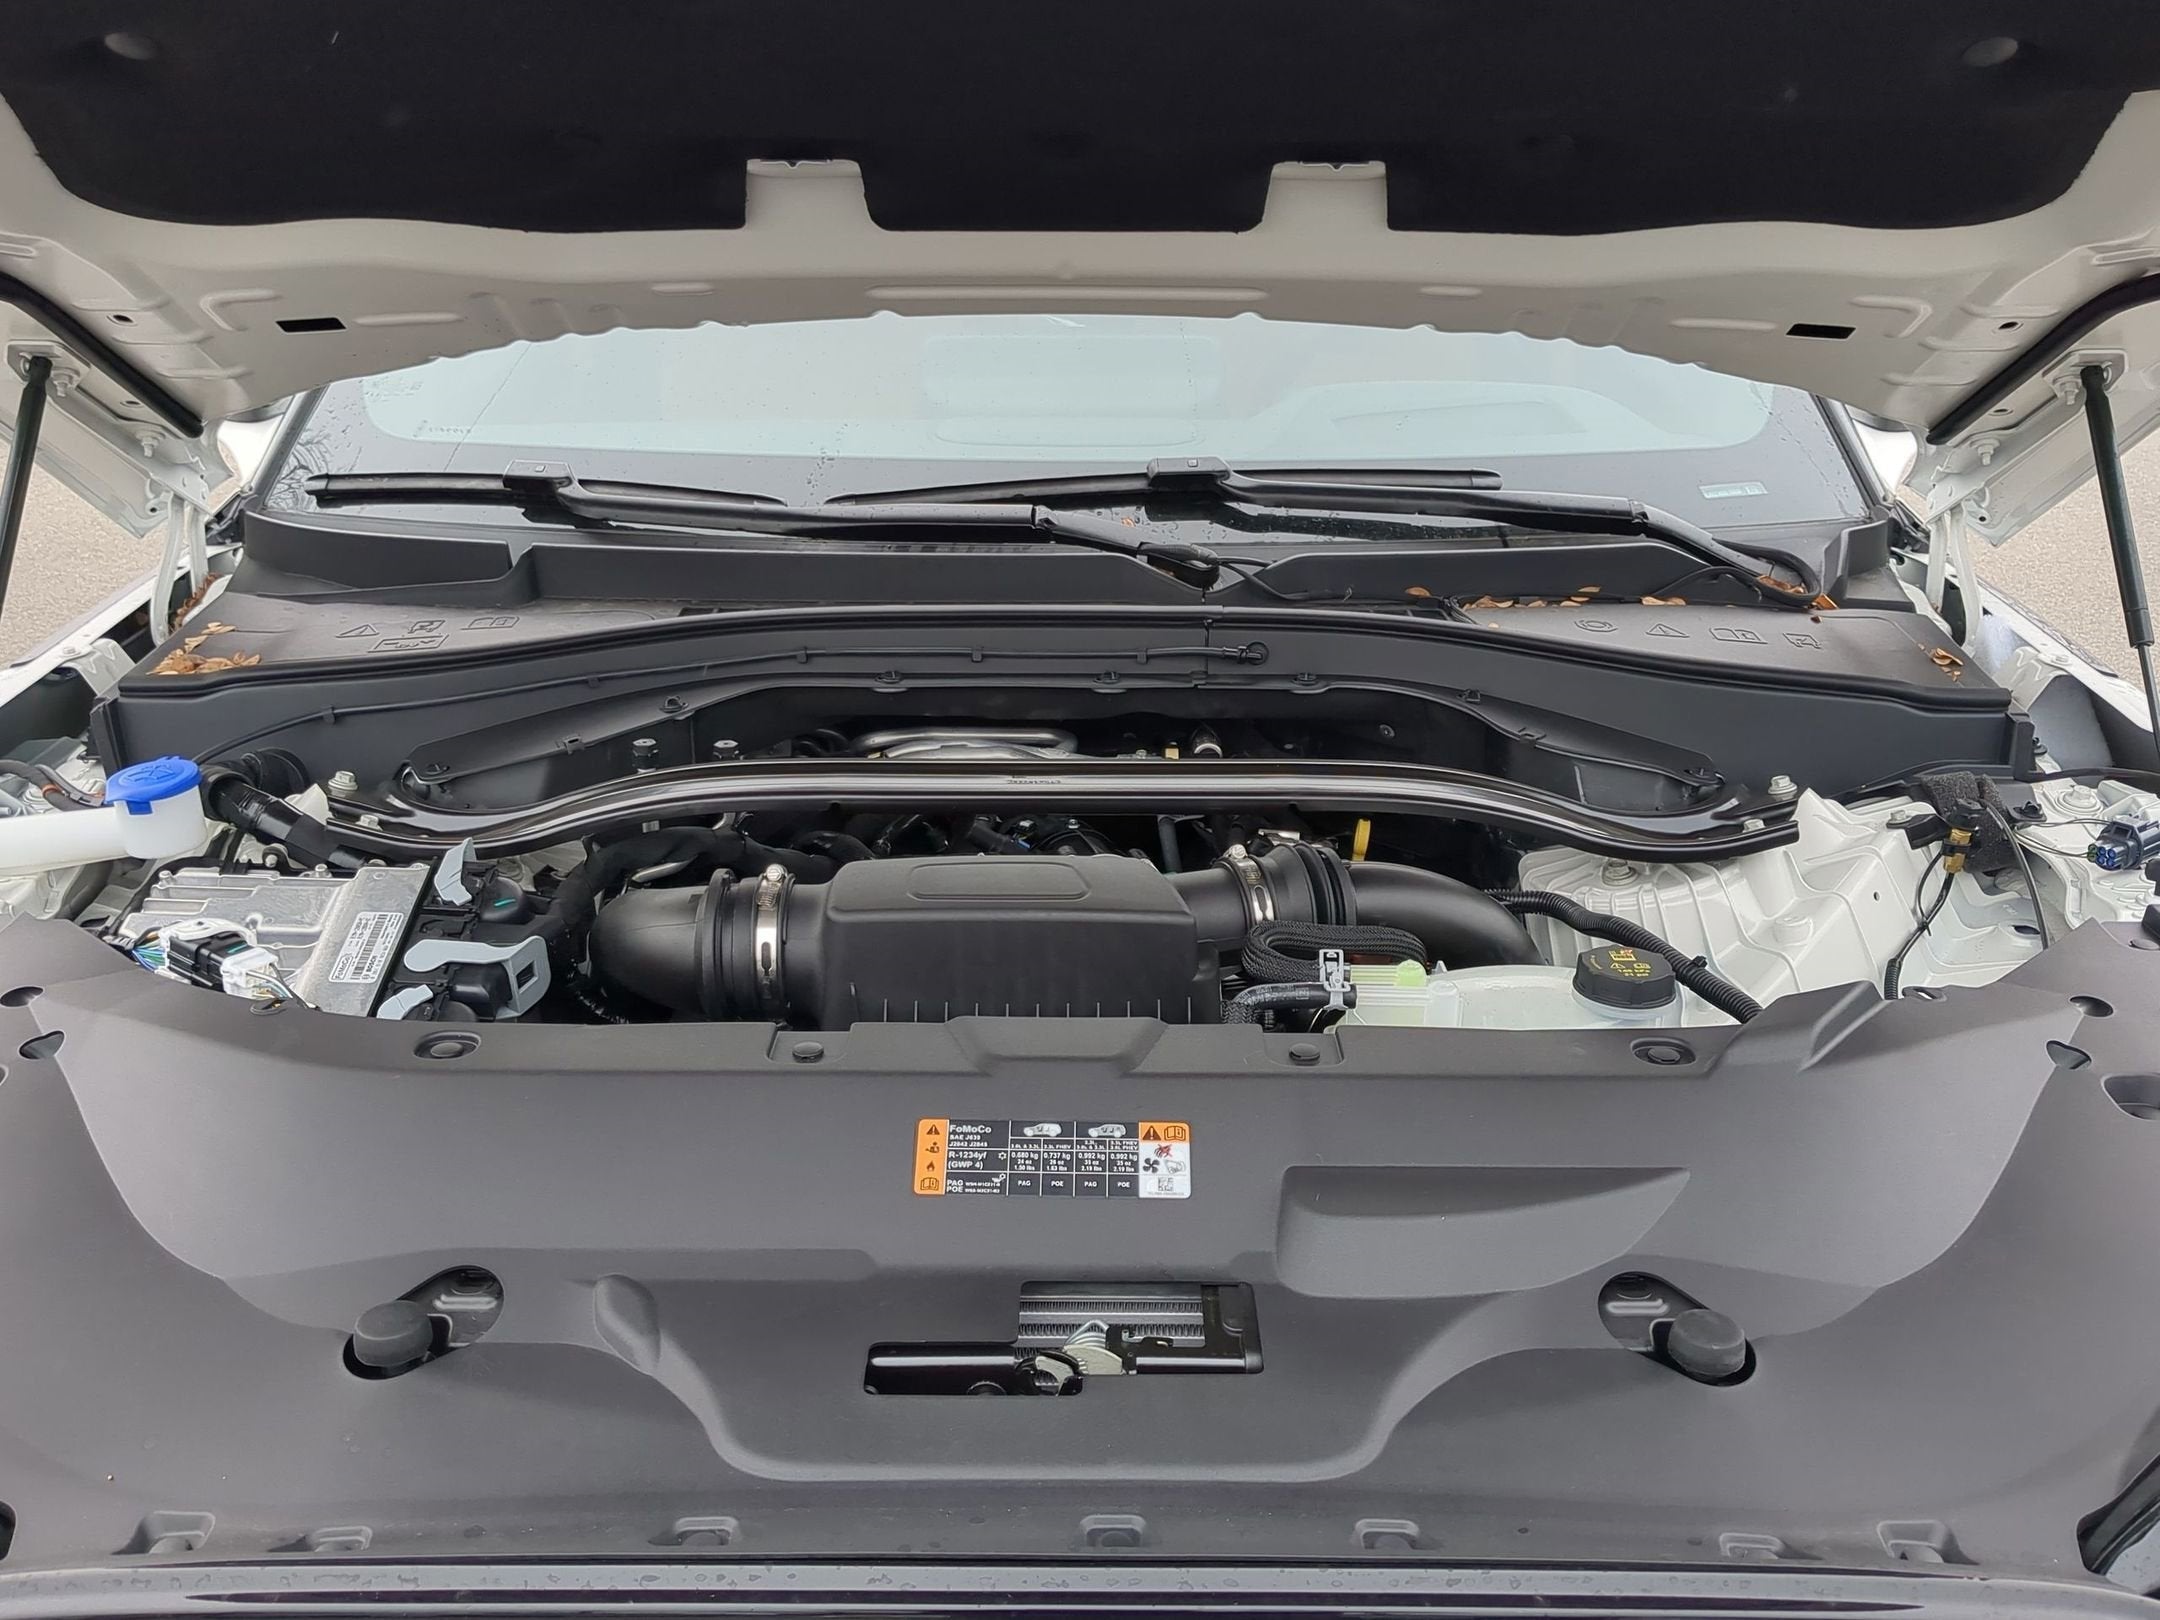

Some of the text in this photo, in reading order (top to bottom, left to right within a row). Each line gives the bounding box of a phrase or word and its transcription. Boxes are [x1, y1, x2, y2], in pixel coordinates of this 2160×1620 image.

[950, 1125, 992, 1133] FoMoCo
[948, 1151, 987, 1160] R-1234yf
[1030, 1152, 1039, 1160] kg
[974, 1161, 984, 1169] 4)
